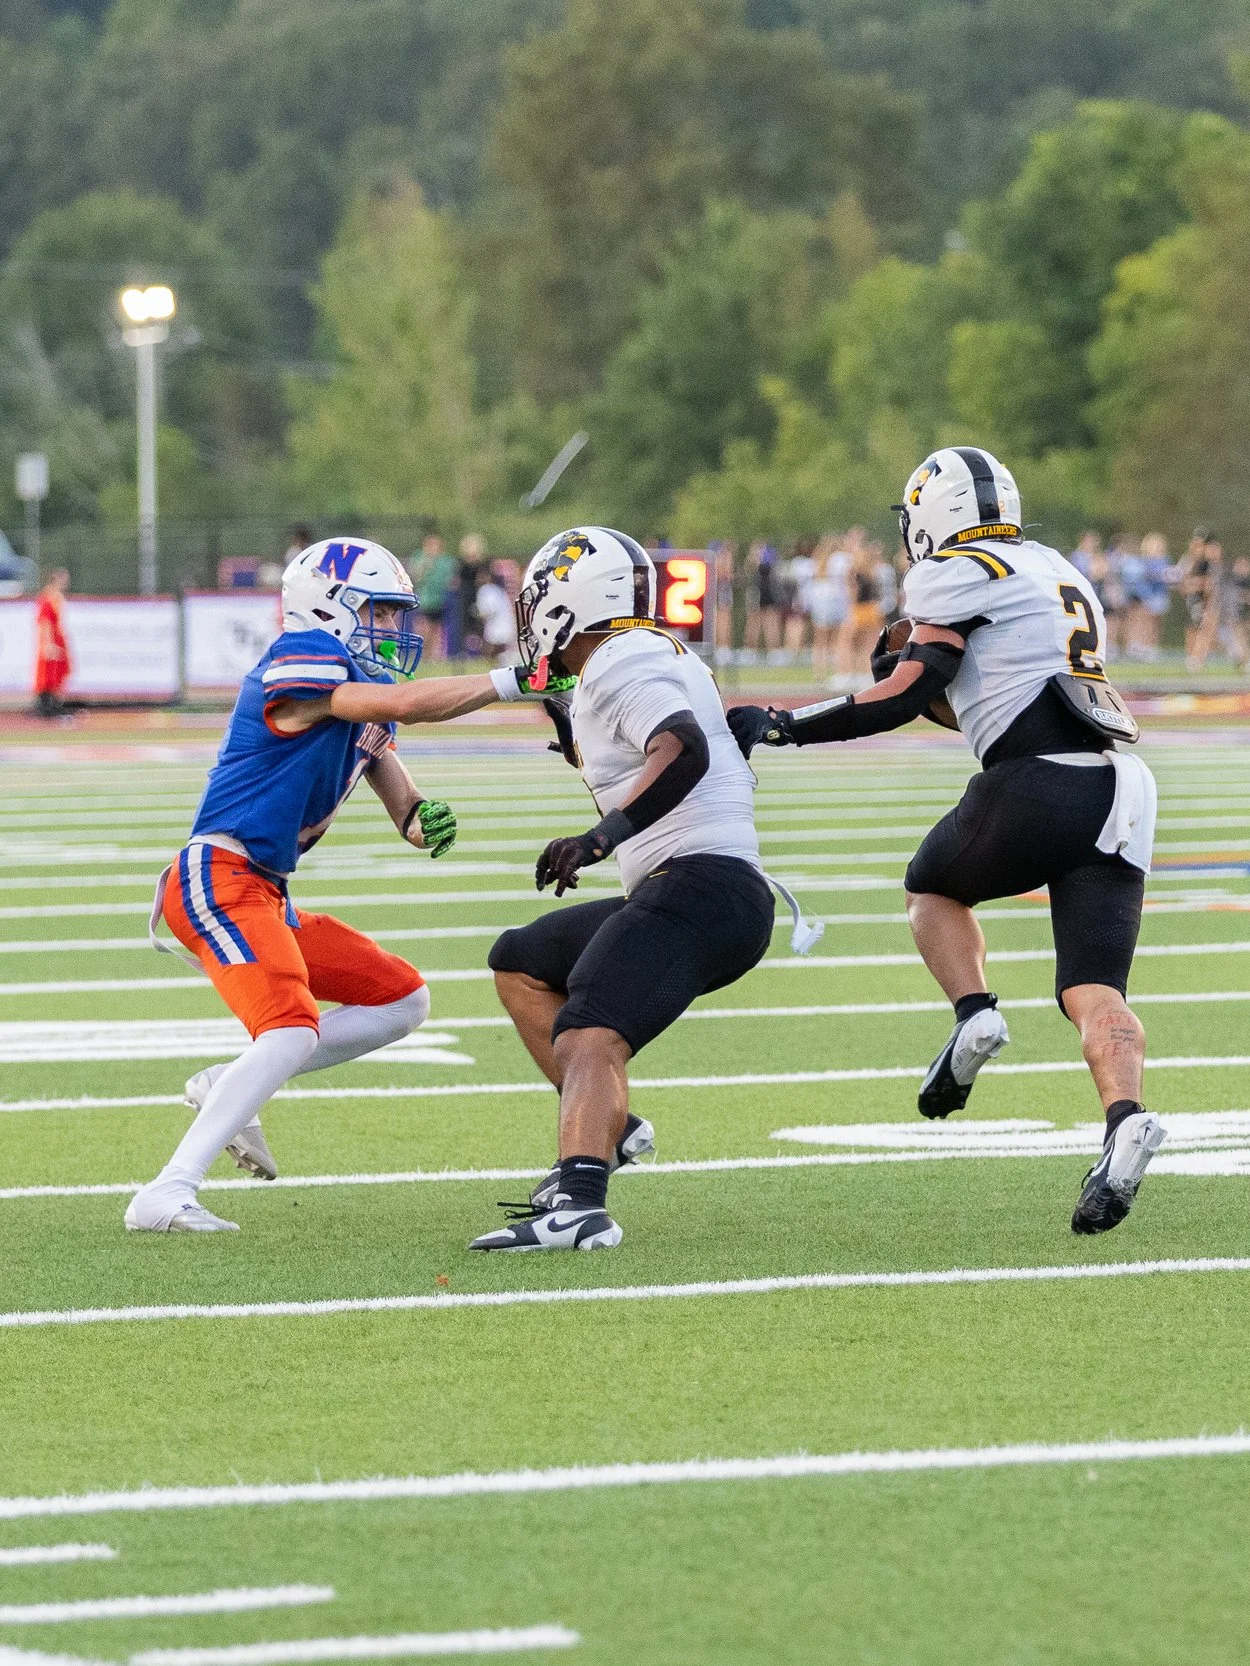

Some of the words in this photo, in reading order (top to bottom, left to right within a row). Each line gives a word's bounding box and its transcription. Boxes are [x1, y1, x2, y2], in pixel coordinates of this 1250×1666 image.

[957, 525, 1018, 543] MOUNTAINEERS
[316, 542, 368, 583] N
[664, 558, 707, 625] 2
[1058, 583, 1106, 681] 2
